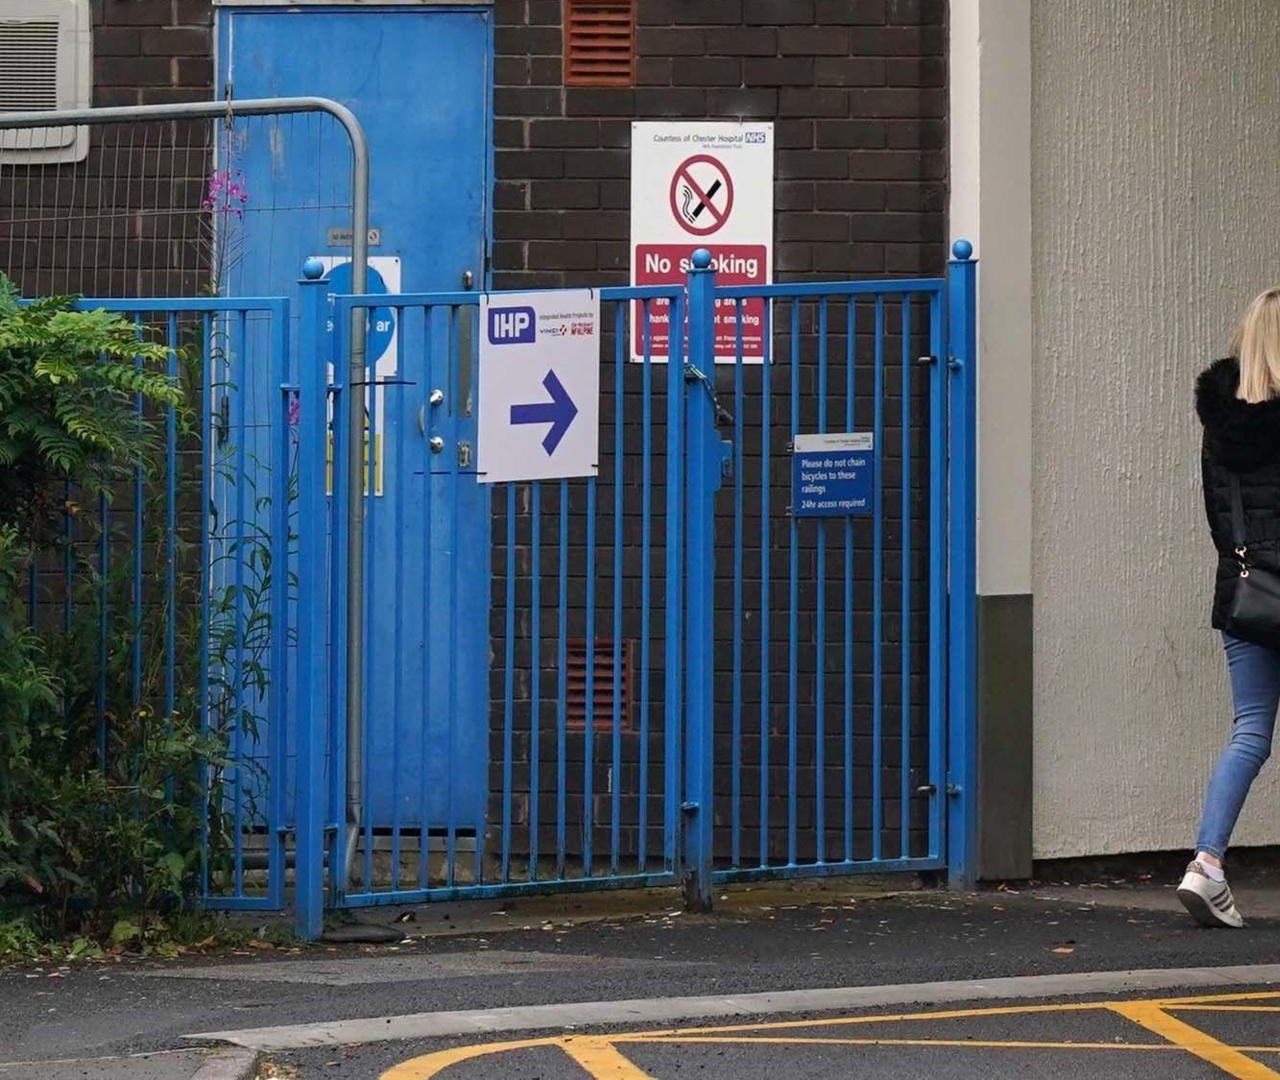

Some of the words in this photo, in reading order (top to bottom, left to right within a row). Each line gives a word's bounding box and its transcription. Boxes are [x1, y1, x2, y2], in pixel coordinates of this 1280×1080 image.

[653, 134, 682, 143] Countess
[683, 133, 691, 143] of
[692, 133, 717, 143] Chester
[718, 133, 744, 145] Hospital
[746, 133, 766, 143] NHS
[645, 253, 671, 274] No
[679, 253, 758, 278] soking
[493, 312, 530, 338] IHP
[649, 313, 669, 324] hank
[723, 313, 760, 326] smking
[801, 459, 823, 469] Please
[824, 459, 833, 468] do
[834, 458, 846, 468] not
[847, 458, 866, 467] chain
[801, 471, 828, 482] bicycles
[829, 472, 837, 480] to
[837, 470, 856, 479] these
[801, 483, 826, 495] railings
[801, 500, 816, 509] 24hr
[818, 501, 838, 509] access
[838, 498, 866, 510] required
